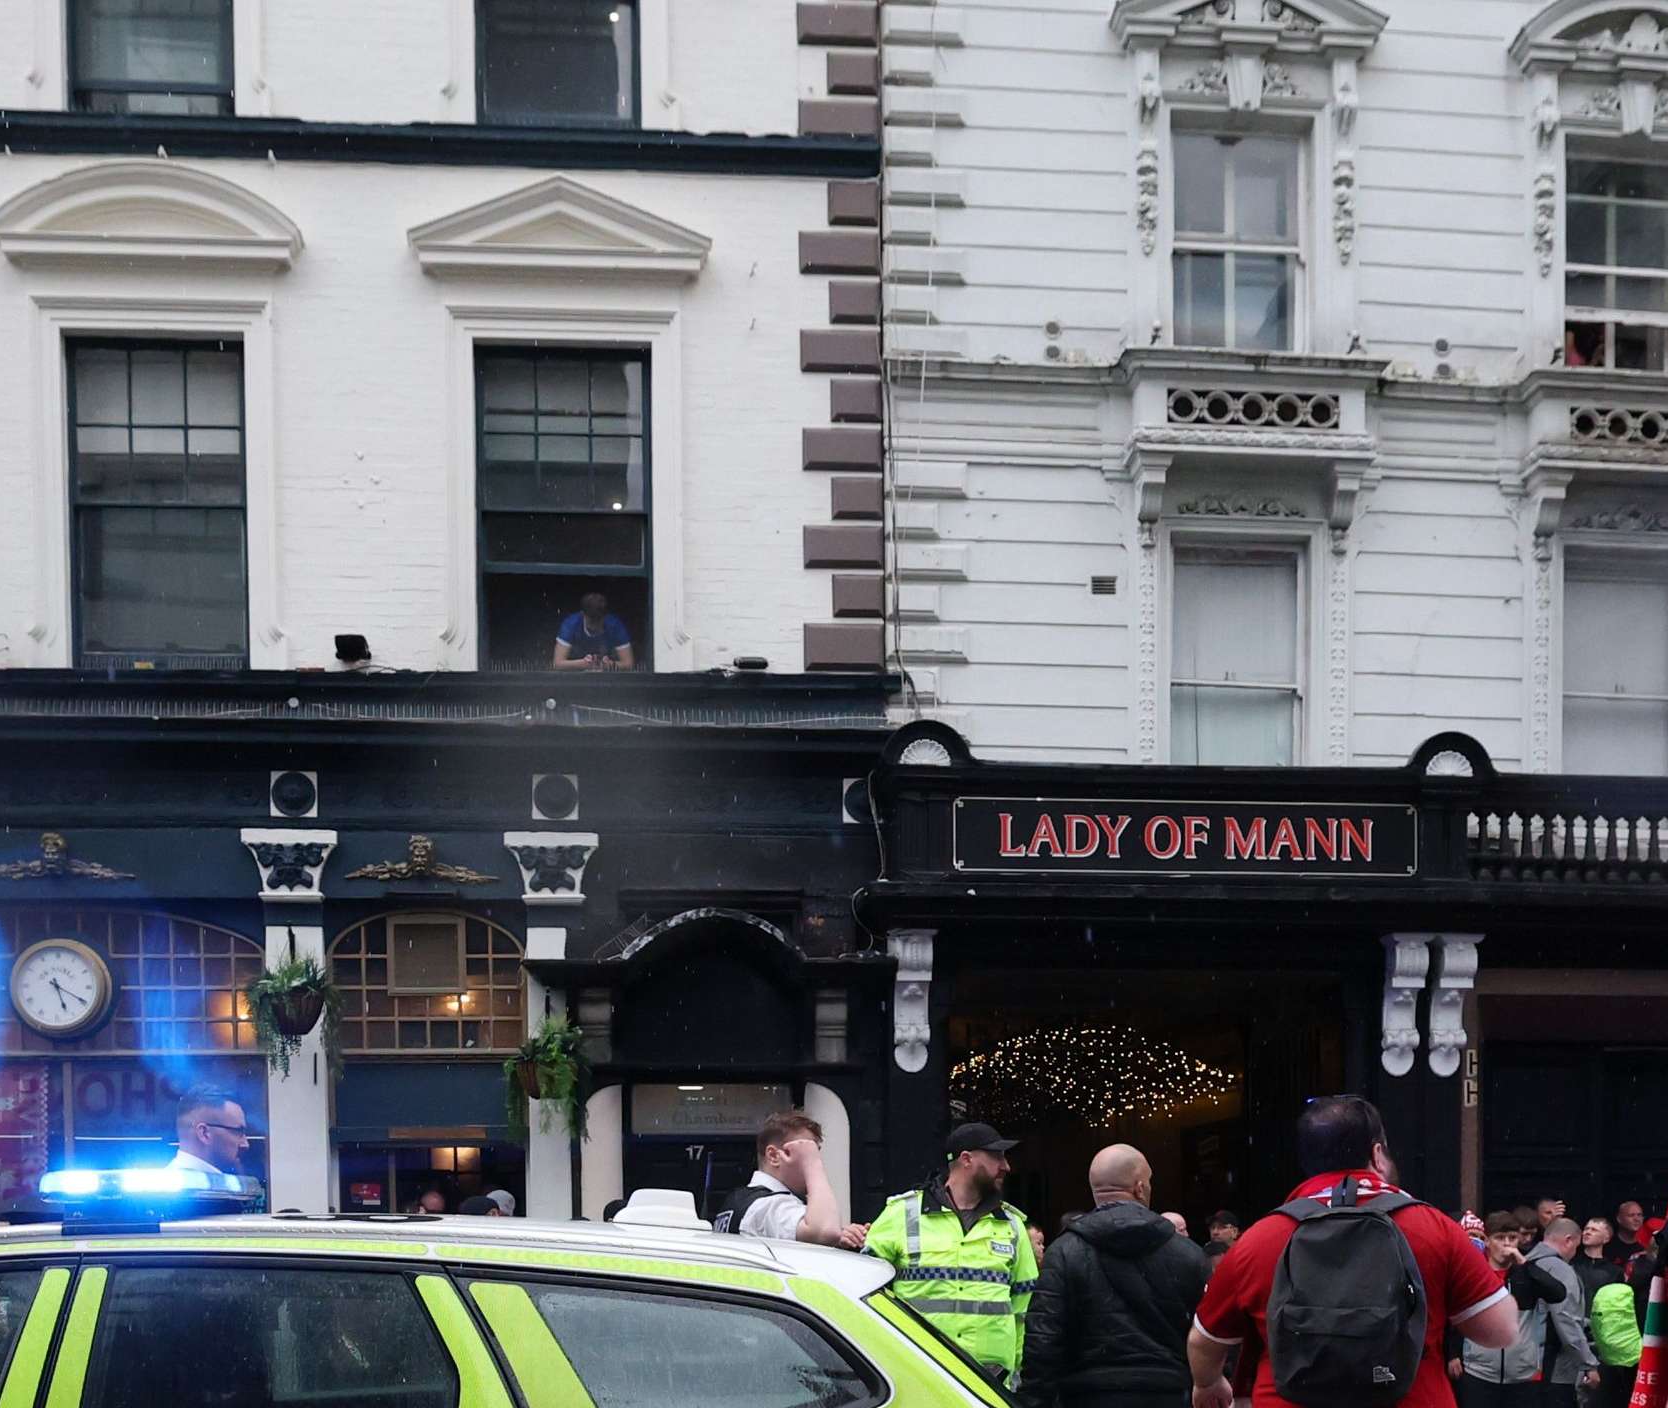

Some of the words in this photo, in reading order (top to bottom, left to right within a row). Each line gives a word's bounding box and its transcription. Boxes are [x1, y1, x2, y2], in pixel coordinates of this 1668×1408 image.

[998, 813, 1131, 858] LADY
[1144, 815, 1210, 859] OF
[1224, 816, 1373, 861] MANN
[686, 1145, 704, 1160] 17
